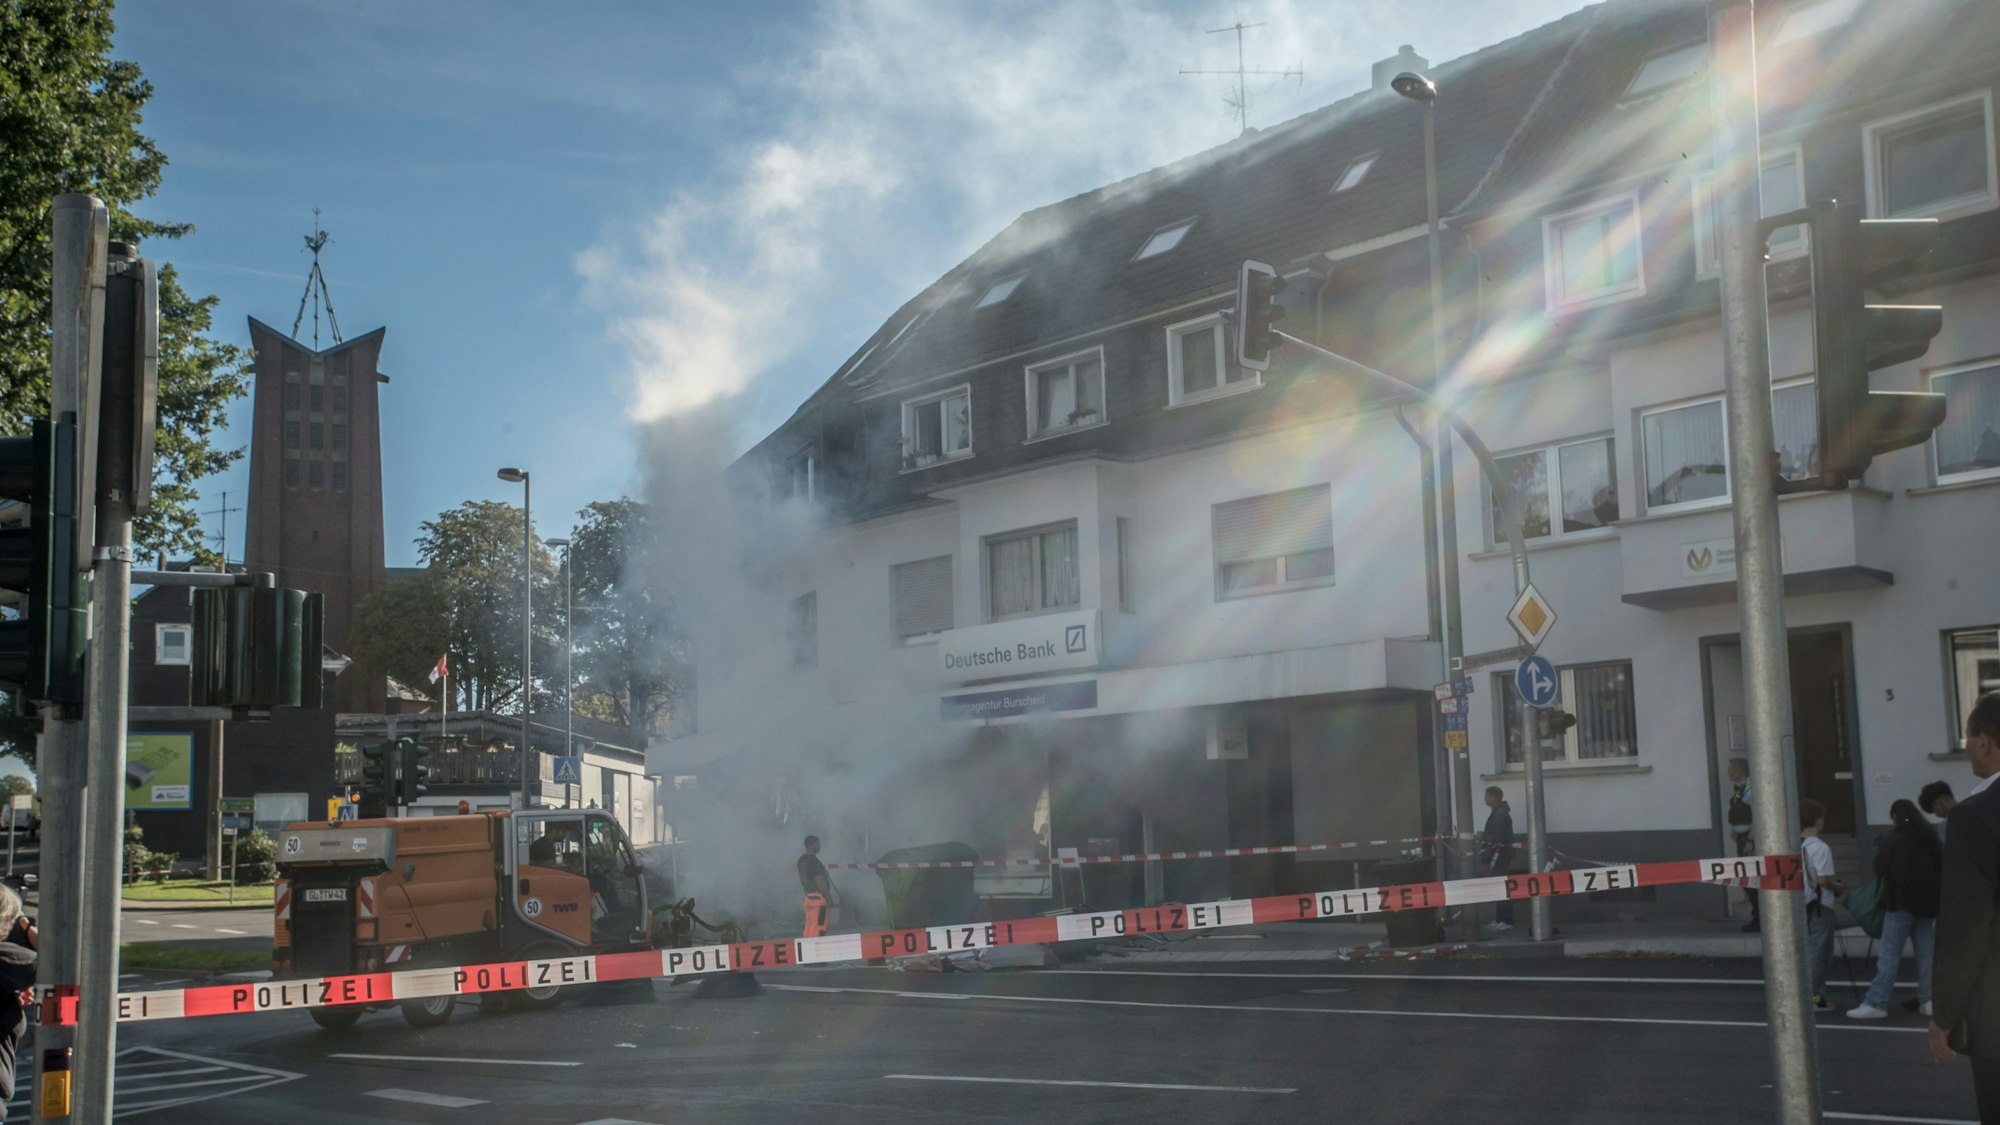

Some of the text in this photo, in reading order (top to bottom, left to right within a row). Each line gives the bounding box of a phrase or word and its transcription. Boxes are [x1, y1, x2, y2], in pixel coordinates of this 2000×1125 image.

[944, 640, 1056, 669] Deutsche Bank
[1003, 694, 1046, 709] Burscheid
[1885, 688, 1894, 701] 3
[287, 839, 299, 852] 50
[527, 901, 539, 914] 50
[233, 978, 372, 1010] POLIZEI
[455, 959, 589, 992] POLIZEI
[669, 941, 803, 973] POLIZEI
[882, 923, 1013, 955] POLIZEI
[1090, 905, 1222, 937] POLIZEI
[1298, 886, 1429, 918] POLIZEI
[1504, 868, 1636, 898] POLIZEI
